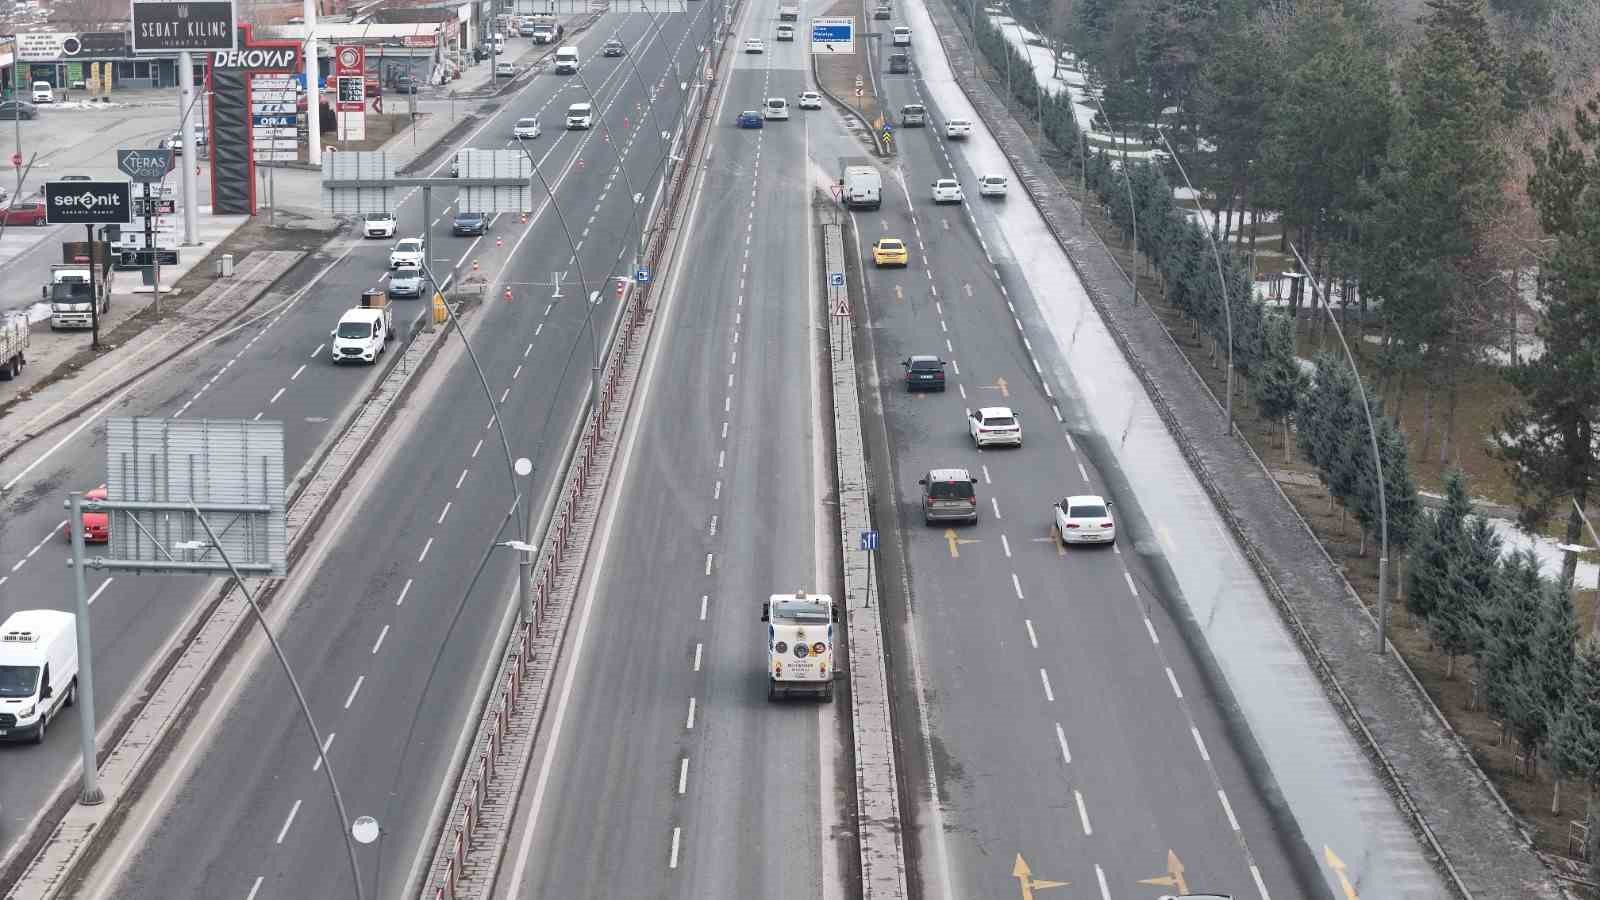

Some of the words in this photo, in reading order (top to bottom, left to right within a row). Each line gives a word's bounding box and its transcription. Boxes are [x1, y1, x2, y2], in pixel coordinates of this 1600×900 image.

[142, 22, 179, 37] SEDAT
[214, 50, 294, 67] DEKOYAP
[129, 157, 165, 169] TERAS
[54, 192, 120, 207] seranit
